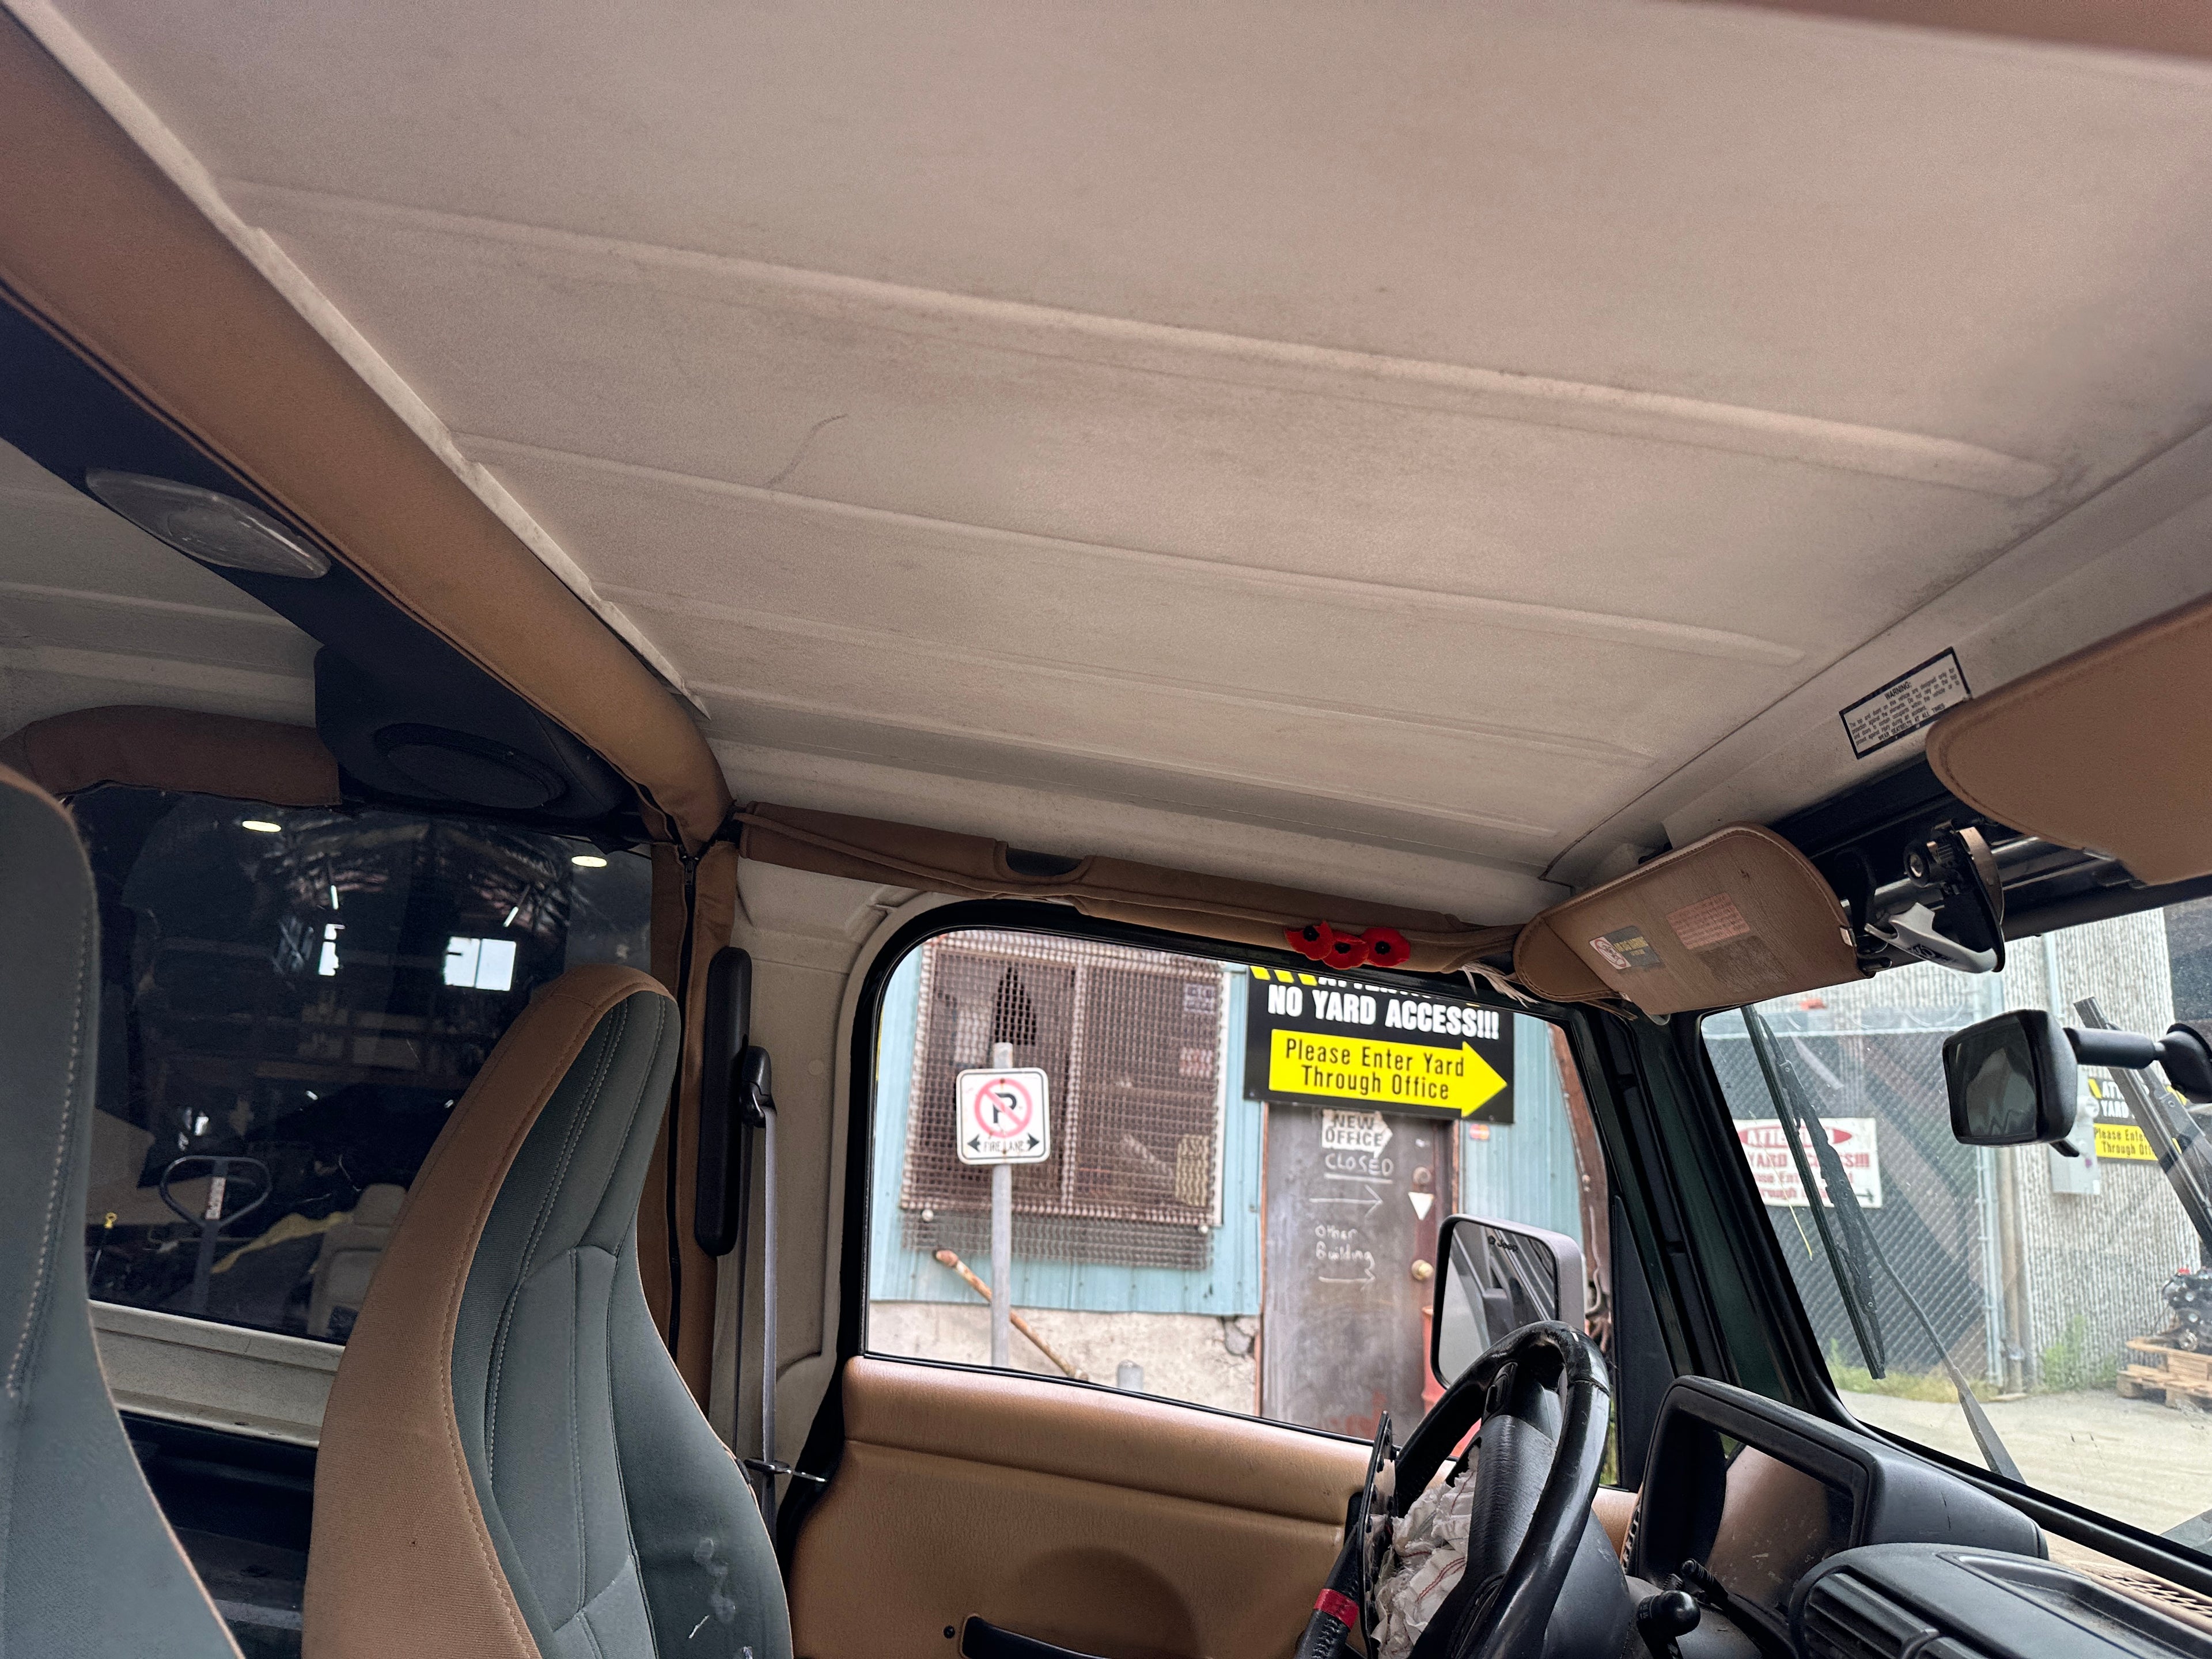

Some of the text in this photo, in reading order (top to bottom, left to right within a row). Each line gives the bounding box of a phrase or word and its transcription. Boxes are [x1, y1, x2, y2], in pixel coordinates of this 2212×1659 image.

[1885, 681, 1912, 699] WARNING:
[1878, 732, 1889, 740] WEAR
[1931, 703, 1945, 713] TIMES
[1268, 984, 1303, 1017] NO
[1312, 989, 1376, 1025] YARD
[1385, 998, 1499, 1040] ACCESS!!!
[1286, 1038, 1464, 1077] Please Enter Yard
[1301, 1064, 1449, 1100] Through Office
[2100, 1099, 2130, 1119] YARD
[1332, 1115, 1376, 1130] NEW
[1325, 1129, 1383, 1147] OFFICE
[2124, 1128, 2144, 1142] Ente
[2101, 1140, 2136, 1156] Through
[1325, 1152, 1394, 1176] CLOSED
[1497, 1238, 1518, 1253] Jeep
